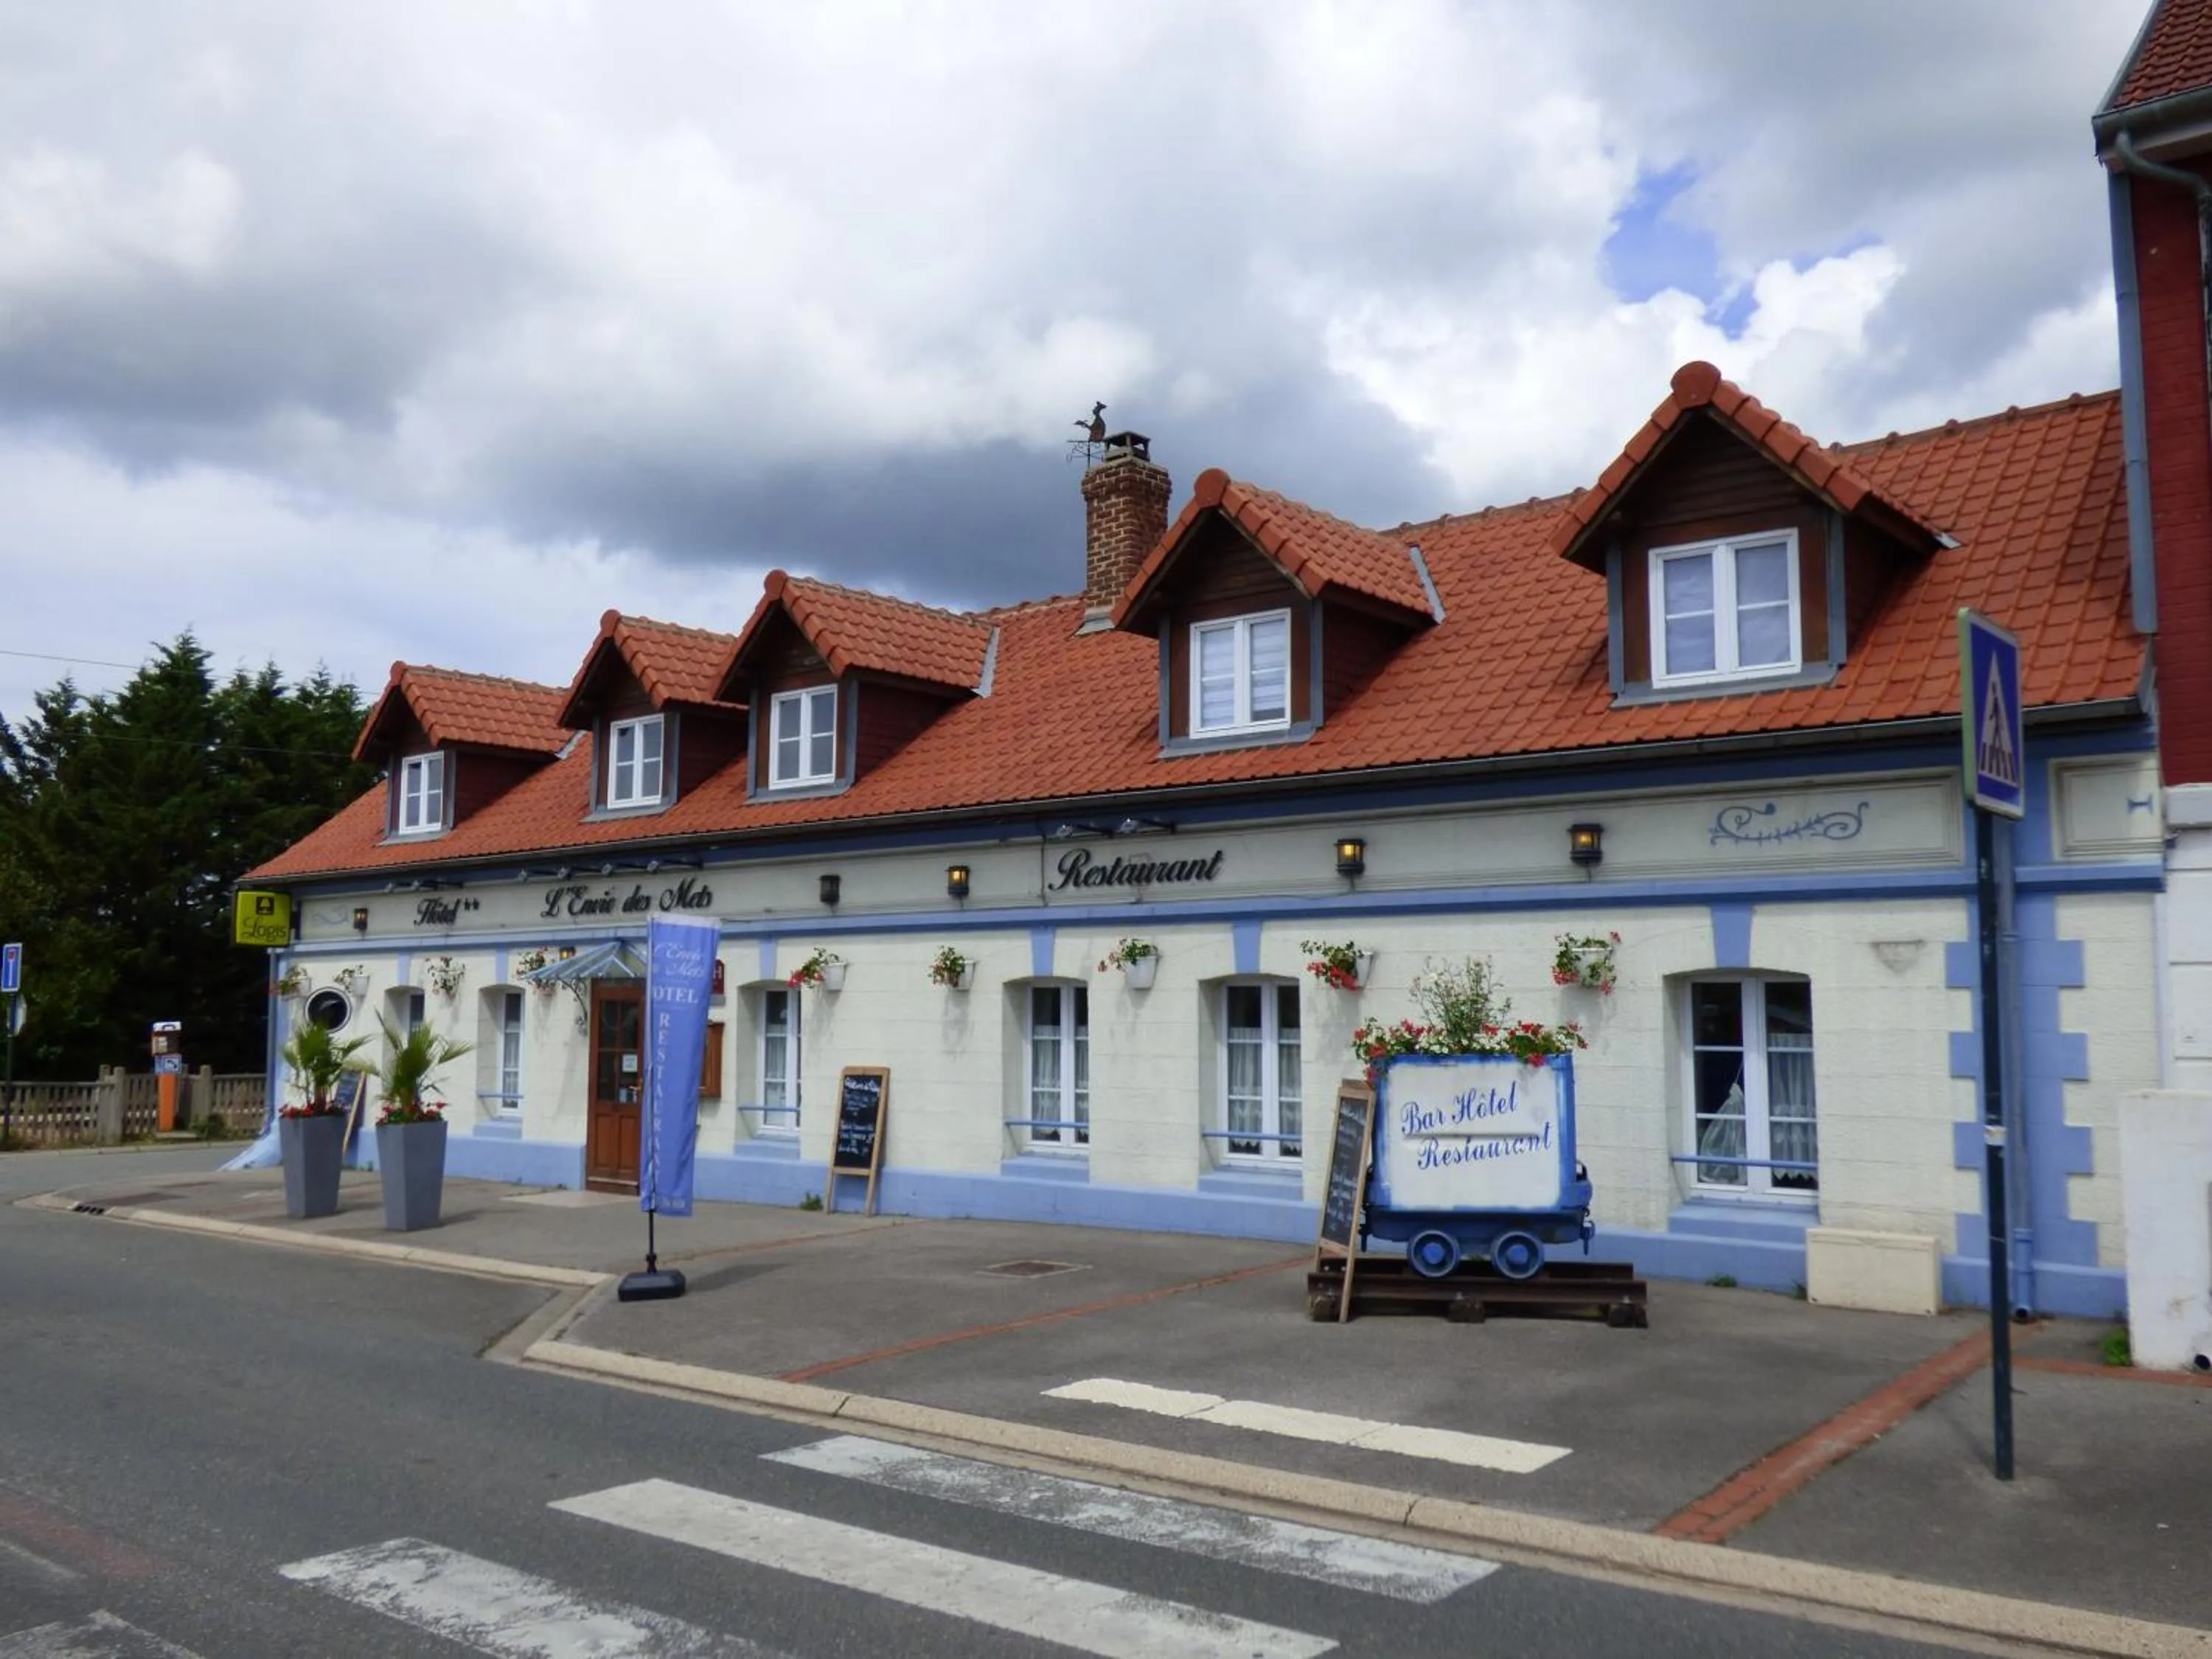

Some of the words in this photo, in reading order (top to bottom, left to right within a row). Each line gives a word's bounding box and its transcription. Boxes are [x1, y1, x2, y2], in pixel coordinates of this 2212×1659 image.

[1048, 848, 1224, 891] Restaurant
[540, 886, 616, 917] L'Envie
[622, 884, 652, 913] des
[659, 877, 713, 911] Mets
[241, 916, 287, 942] Logis
[653, 985, 699, 1004] OTEL
[1401, 1101, 1446, 1135] Bar
[1452, 1080, 1517, 1124] Hôtel
[1417, 1121, 1551, 1170] Restaurant
